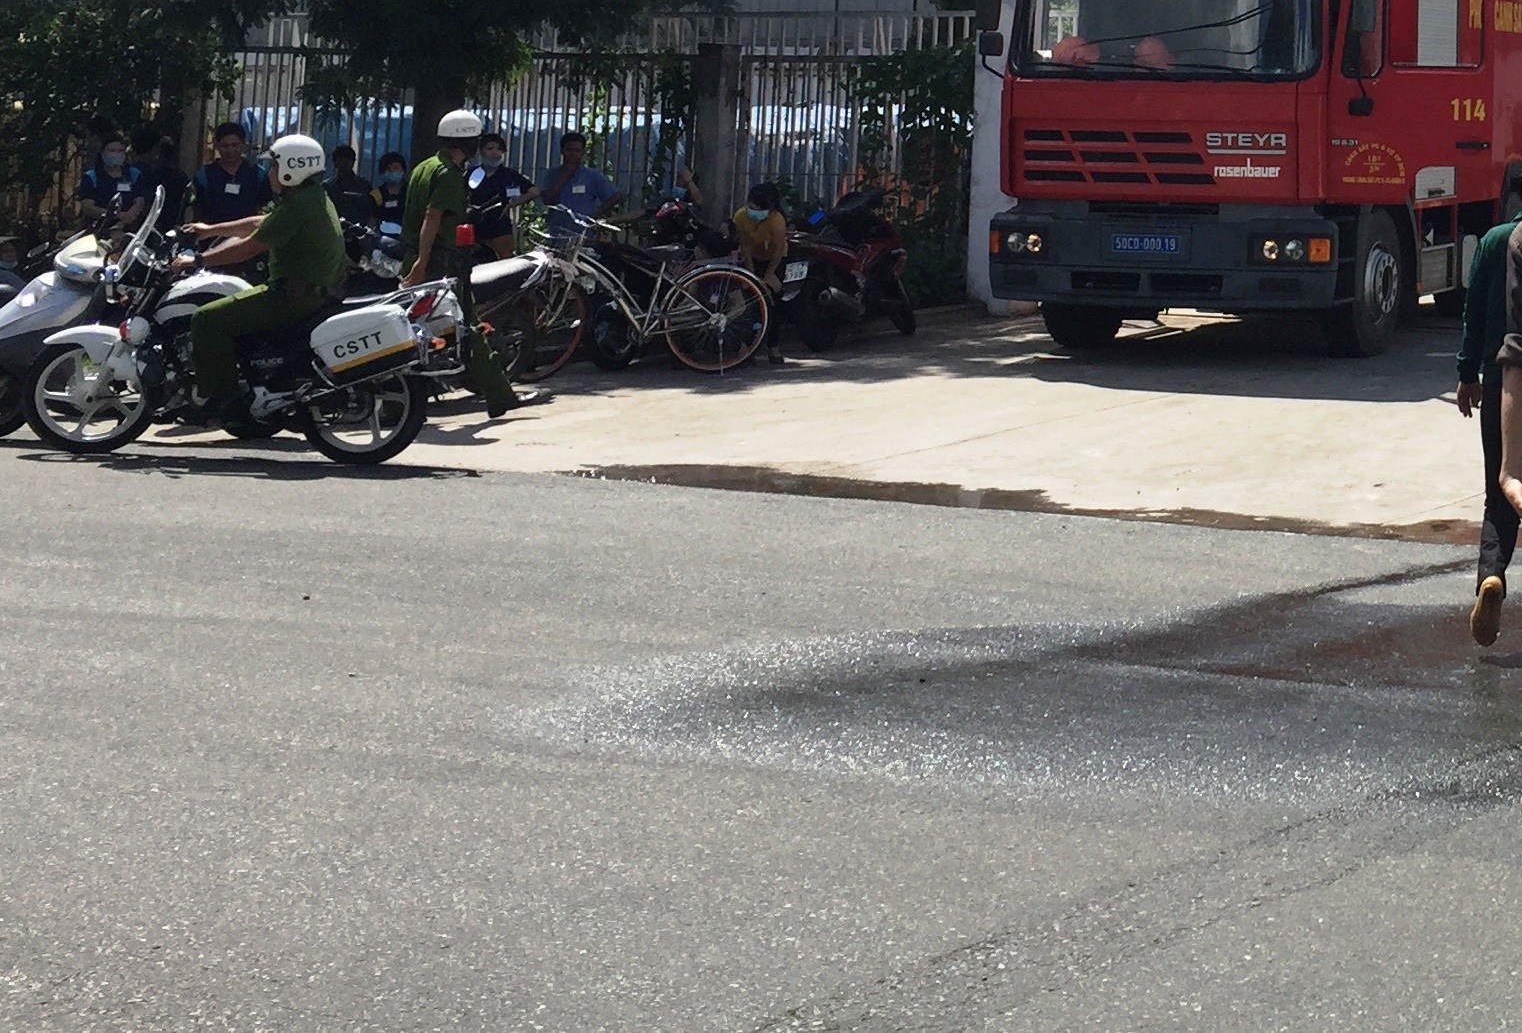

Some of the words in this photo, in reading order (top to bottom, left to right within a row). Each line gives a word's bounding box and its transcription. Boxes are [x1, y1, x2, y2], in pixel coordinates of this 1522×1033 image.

[1451, 98, 1486, 121] 114
[1206, 132, 1287, 147] STEYR
[287, 155, 321, 169] CSTT
[1213, 157, 1281, 177] rosenbauer
[333, 331, 382, 358] CSTT
